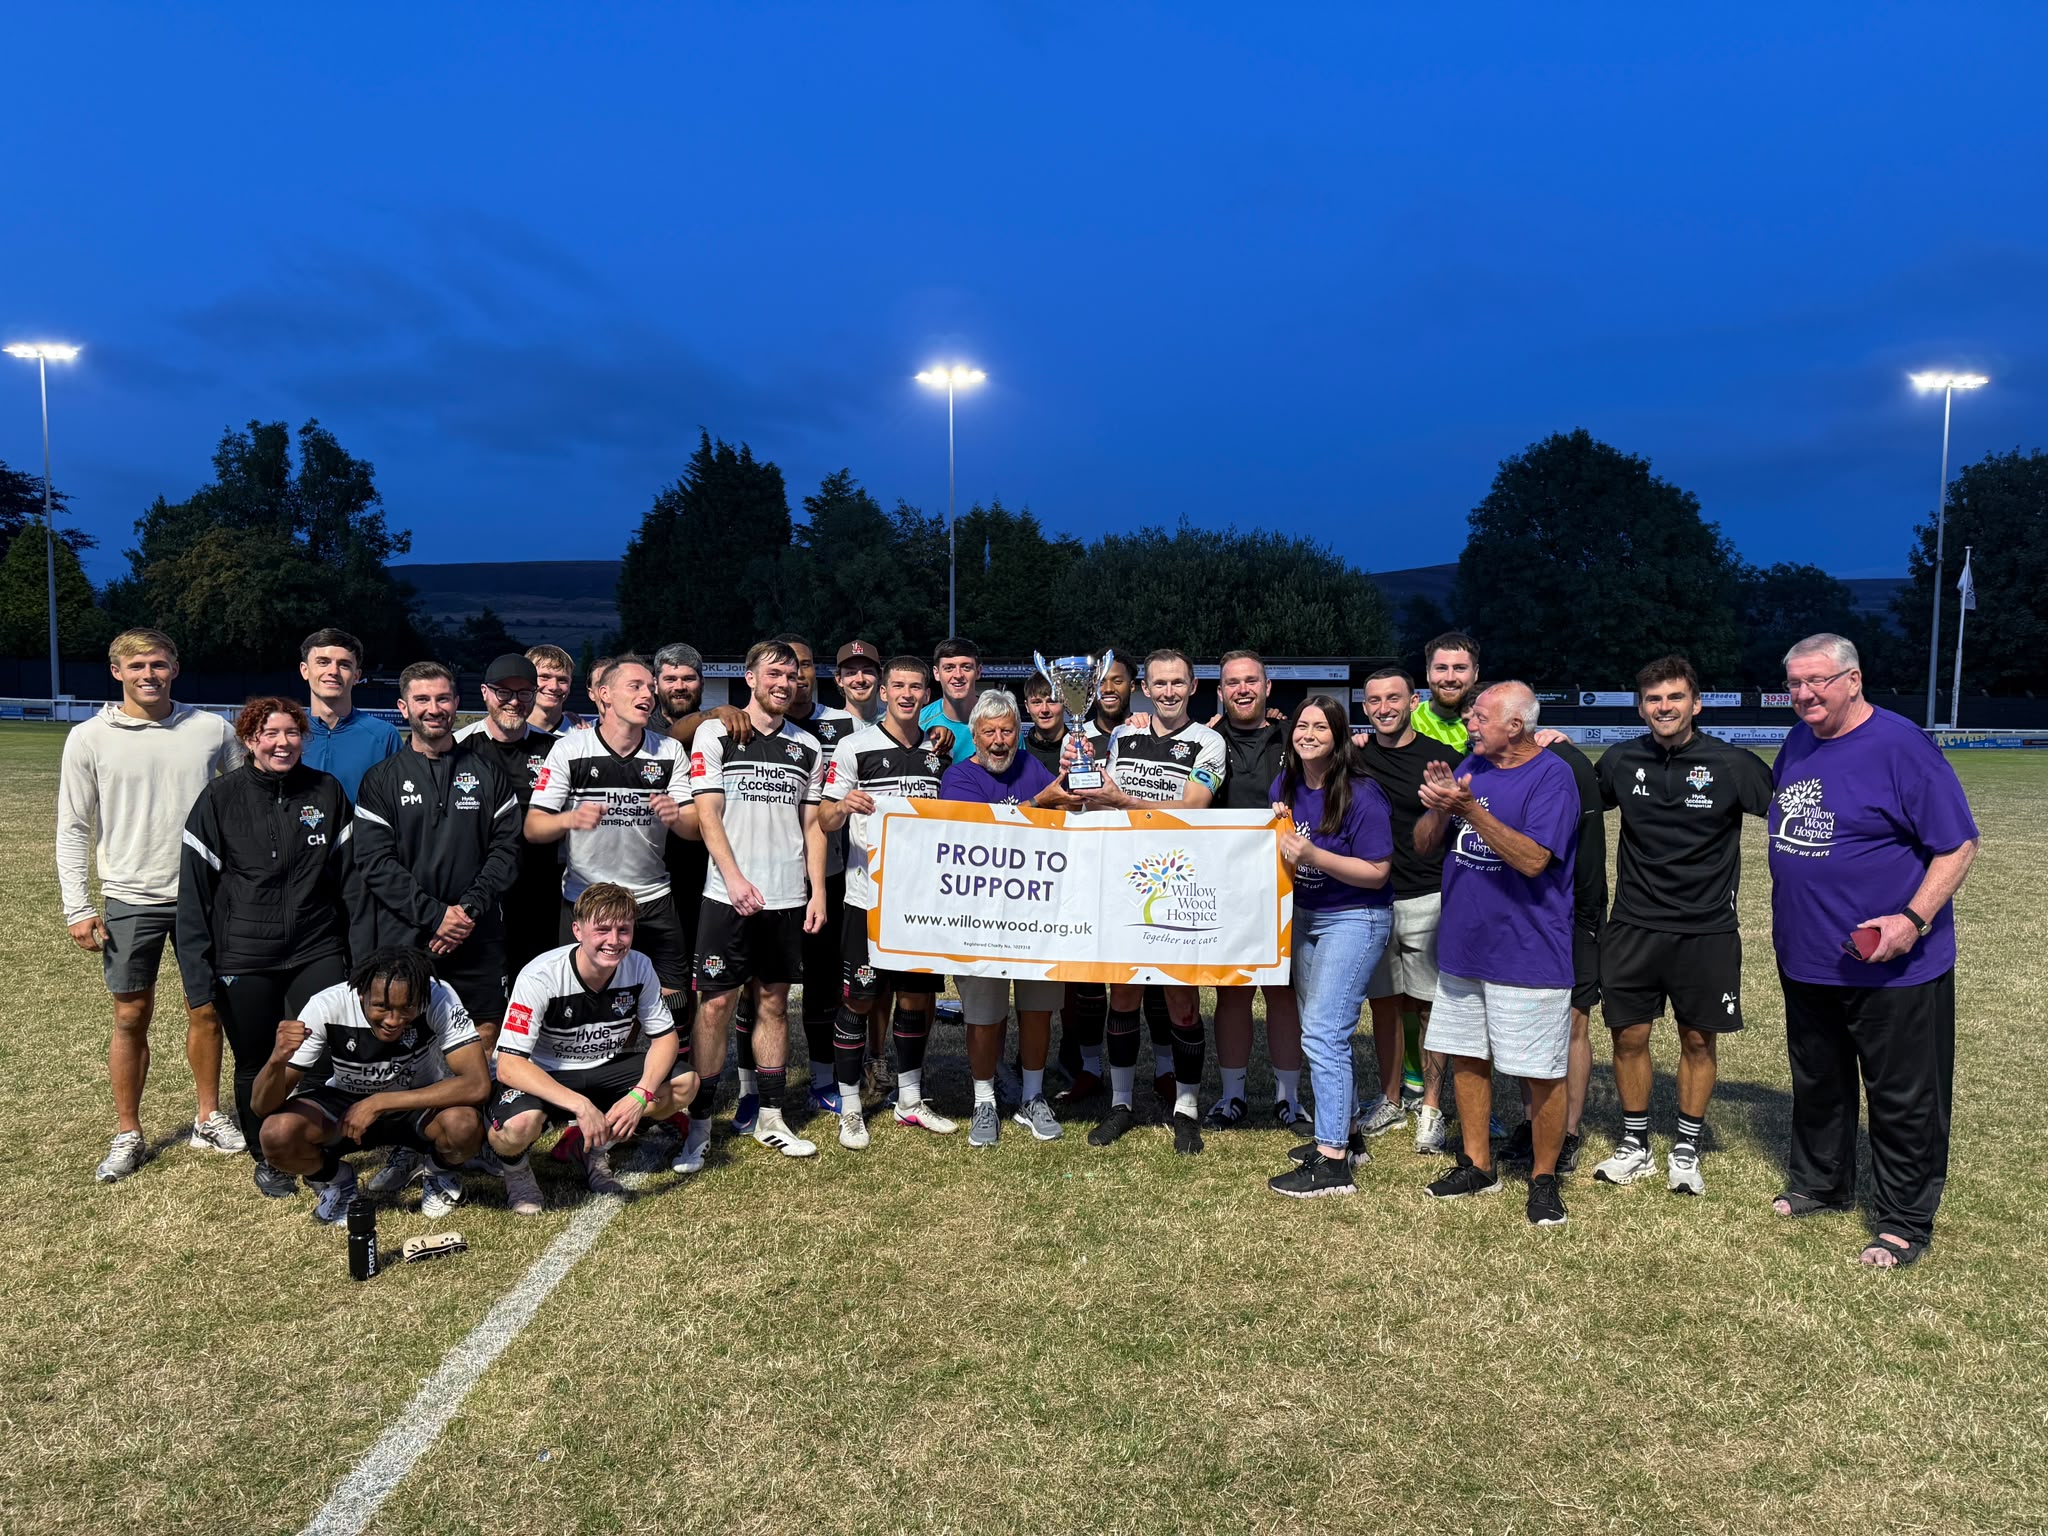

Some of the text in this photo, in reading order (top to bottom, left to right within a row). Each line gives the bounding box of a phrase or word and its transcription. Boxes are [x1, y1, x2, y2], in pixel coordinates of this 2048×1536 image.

[1764, 694, 1790, 702] 3939
[1586, 729, 1600, 738] DS
[755, 766, 786, 780] Hyde
[1134, 763, 1164, 777] Hyde
[738, 776, 797, 794] Accessibe
[900, 780, 926, 794] Hyde
[1119, 772, 1177, 792] Accessible
[1632, 784, 1650, 796] AL
[401, 794, 422, 806] PM
[607, 792, 640, 806] Hyde
[741, 792, 782, 805] Transport
[600, 803, 656, 818] cessible
[1803, 806, 1835, 820] Willow
[600, 818, 635, 827] ansport
[1804, 818, 1834, 831] Wood
[307, 833, 326, 846] CH
[1793, 825, 1833, 842] Hospice
[1468, 841, 1496, 857] Hosp
[1775, 841, 1798, 855] Together
[1811, 849, 1830, 857] care
[937, 842, 1068, 873] PROUD TO
[1297, 863, 1323, 877] ospice
[940, 873, 1054, 902] SUPPORT
[1171, 882, 1217, 897] Willow
[1177, 895, 1217, 910] Wood
[1166, 908, 1217, 926] Hospice
[903, 913, 1093, 937] www.willowwood.org.uk
[1142, 931, 1181, 945] Together
[1198, 936, 1218, 945] care
[1721, 991, 1737, 1003] AL
[576, 1027, 610, 1045] Hyde
[363, 1063, 401, 1080] Hyde
[367, 1238, 376, 1275] FORZA
